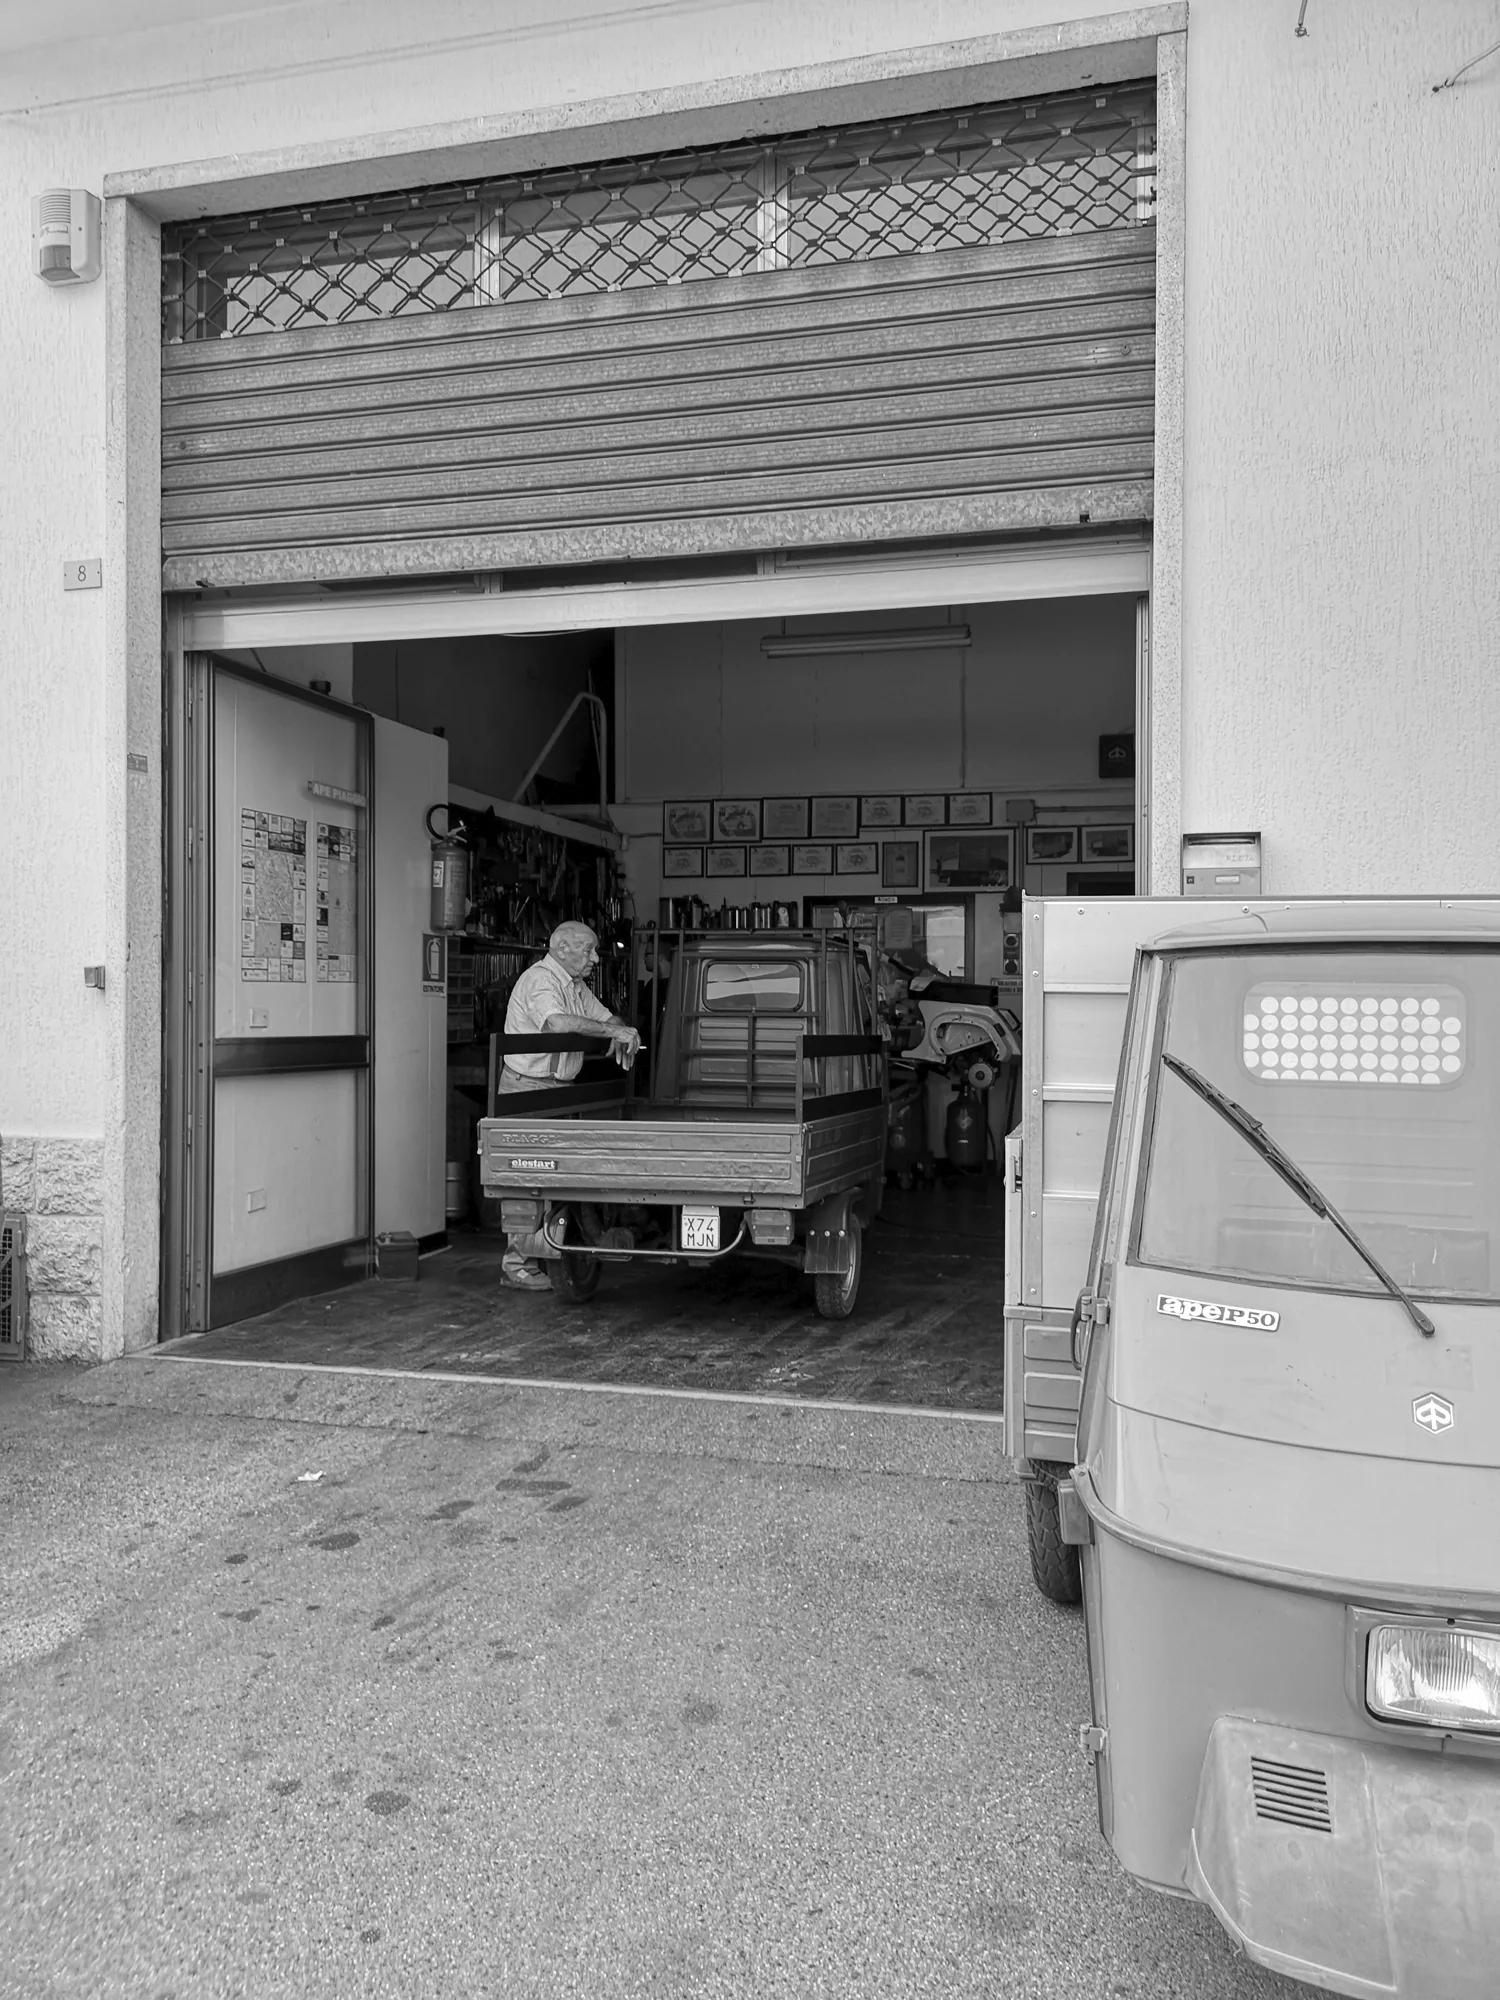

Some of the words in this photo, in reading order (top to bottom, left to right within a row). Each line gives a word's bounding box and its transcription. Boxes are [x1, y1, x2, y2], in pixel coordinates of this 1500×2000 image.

[77, 564, 87, 583] 8
[312, 782, 332, 798] APE
[332, 788, 367, 808] PIAGGIO
[511, 1158, 555, 1170] elestart
[687, 1217, 714, 1232] X74
[687, 1233, 714, 1248] MJN
[1162, 1298, 1222, 1320] ape
[1225, 1308, 1276, 1327] P50
